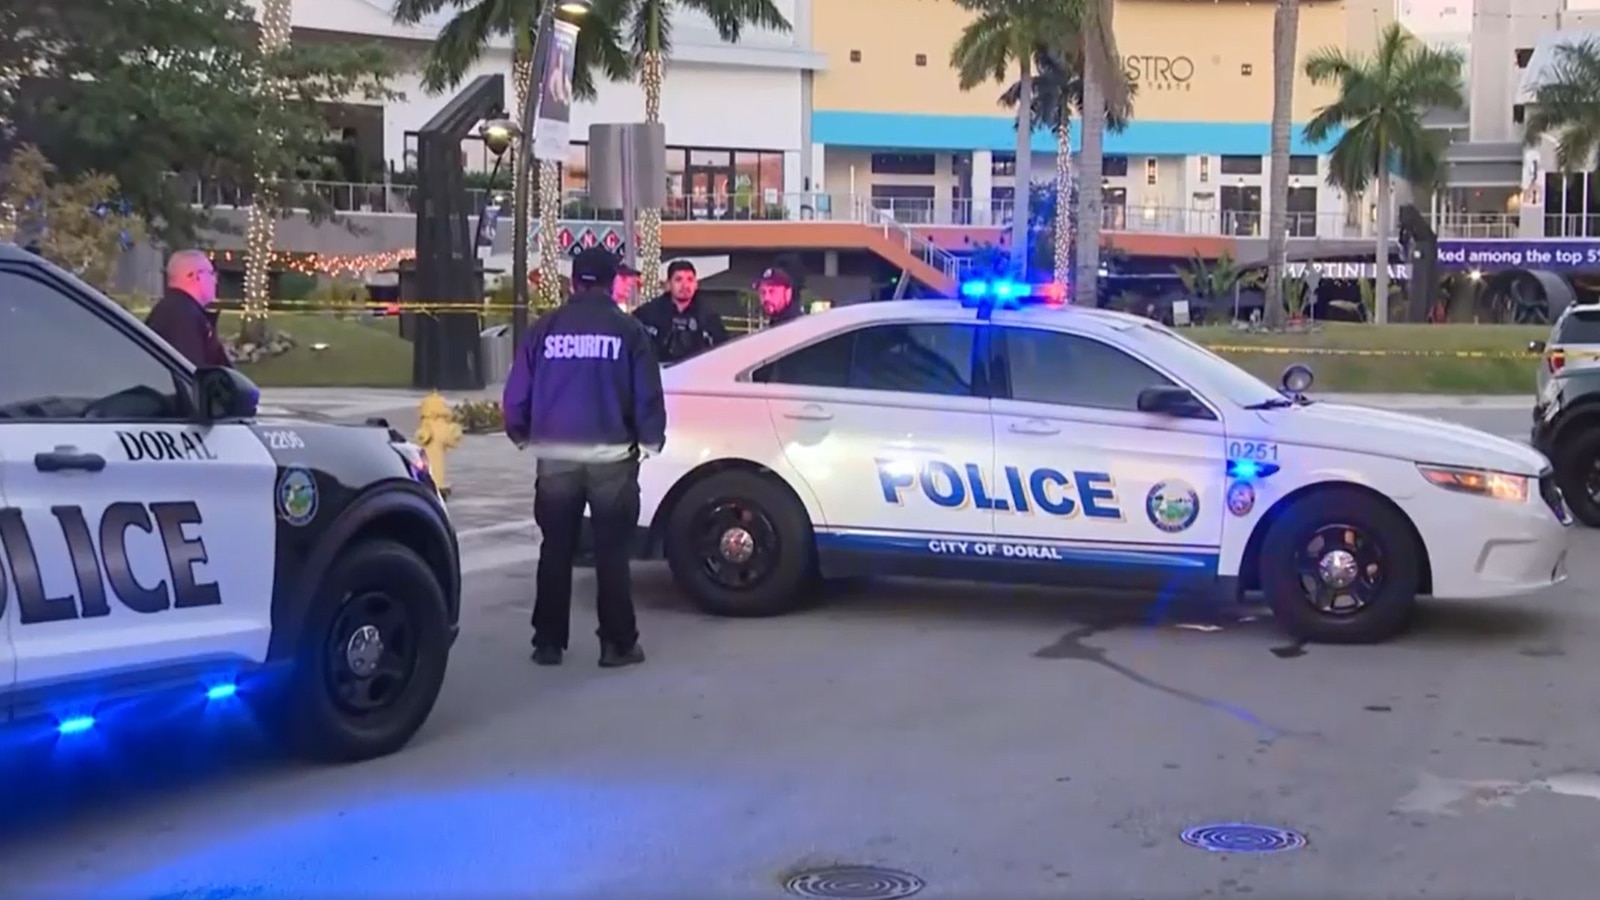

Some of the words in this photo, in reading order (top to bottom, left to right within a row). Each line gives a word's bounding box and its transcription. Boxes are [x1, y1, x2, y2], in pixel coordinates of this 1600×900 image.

[1437, 249, 1465, 262] ked
[1469, 251, 1522, 264] among
[1526, 249, 1551, 263] the
[1556, 249, 1583, 266] top
[544, 335, 622, 360] SECURITY
[115, 430, 218, 461] DORAL
[263, 431, 305, 449] 2206
[1229, 441, 1279, 461] 0251
[873, 457, 1125, 522] POLICE
[928, 540, 969, 554] CITY
[974, 543, 996, 556] OF
[1002, 544, 1063, 560] DORAL
[0, 500, 222, 625] LICE
